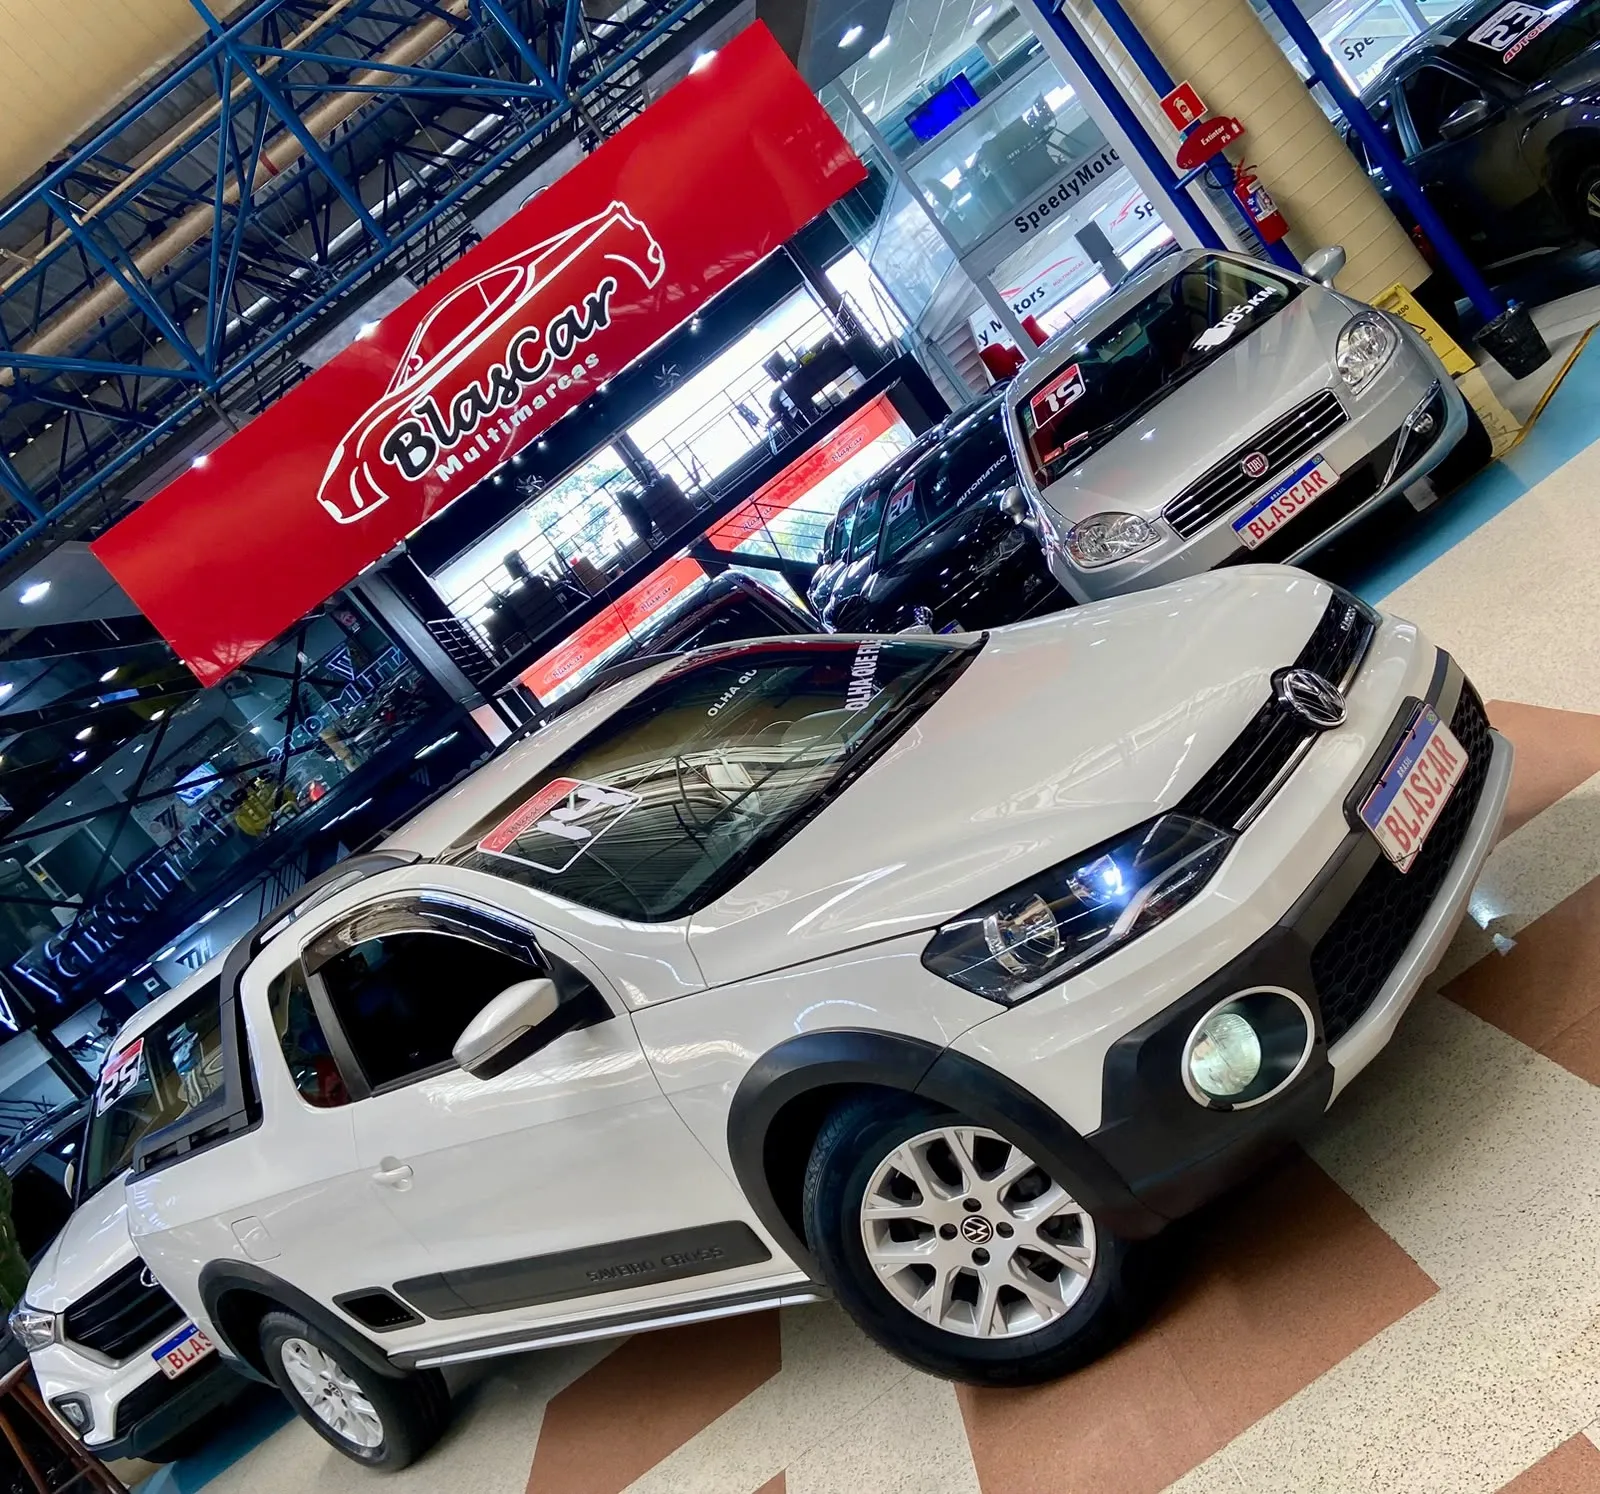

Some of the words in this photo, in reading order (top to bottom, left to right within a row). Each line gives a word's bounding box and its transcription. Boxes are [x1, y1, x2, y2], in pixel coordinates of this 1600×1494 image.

[1479, 6, 1542, 49] 23
[379, 276, 618, 482] BlasCar
[1044, 376, 1083, 412] 15
[435, 352, 600, 482] Multimarcas
[1247, 456, 1264, 473] FIAT
[1247, 469, 1328, 540] BLASCAR
[707, 684, 741, 717] OLHA
[844, 676, 875, 711] OLHA
[1396, 757, 1413, 779] BRASIL
[1384, 734, 1458, 853] BLASCAR
[99, 1054, 138, 1111] 25
[585, 1261, 656, 1283] SAVEIRO
[660, 1244, 725, 1268] CROSS
